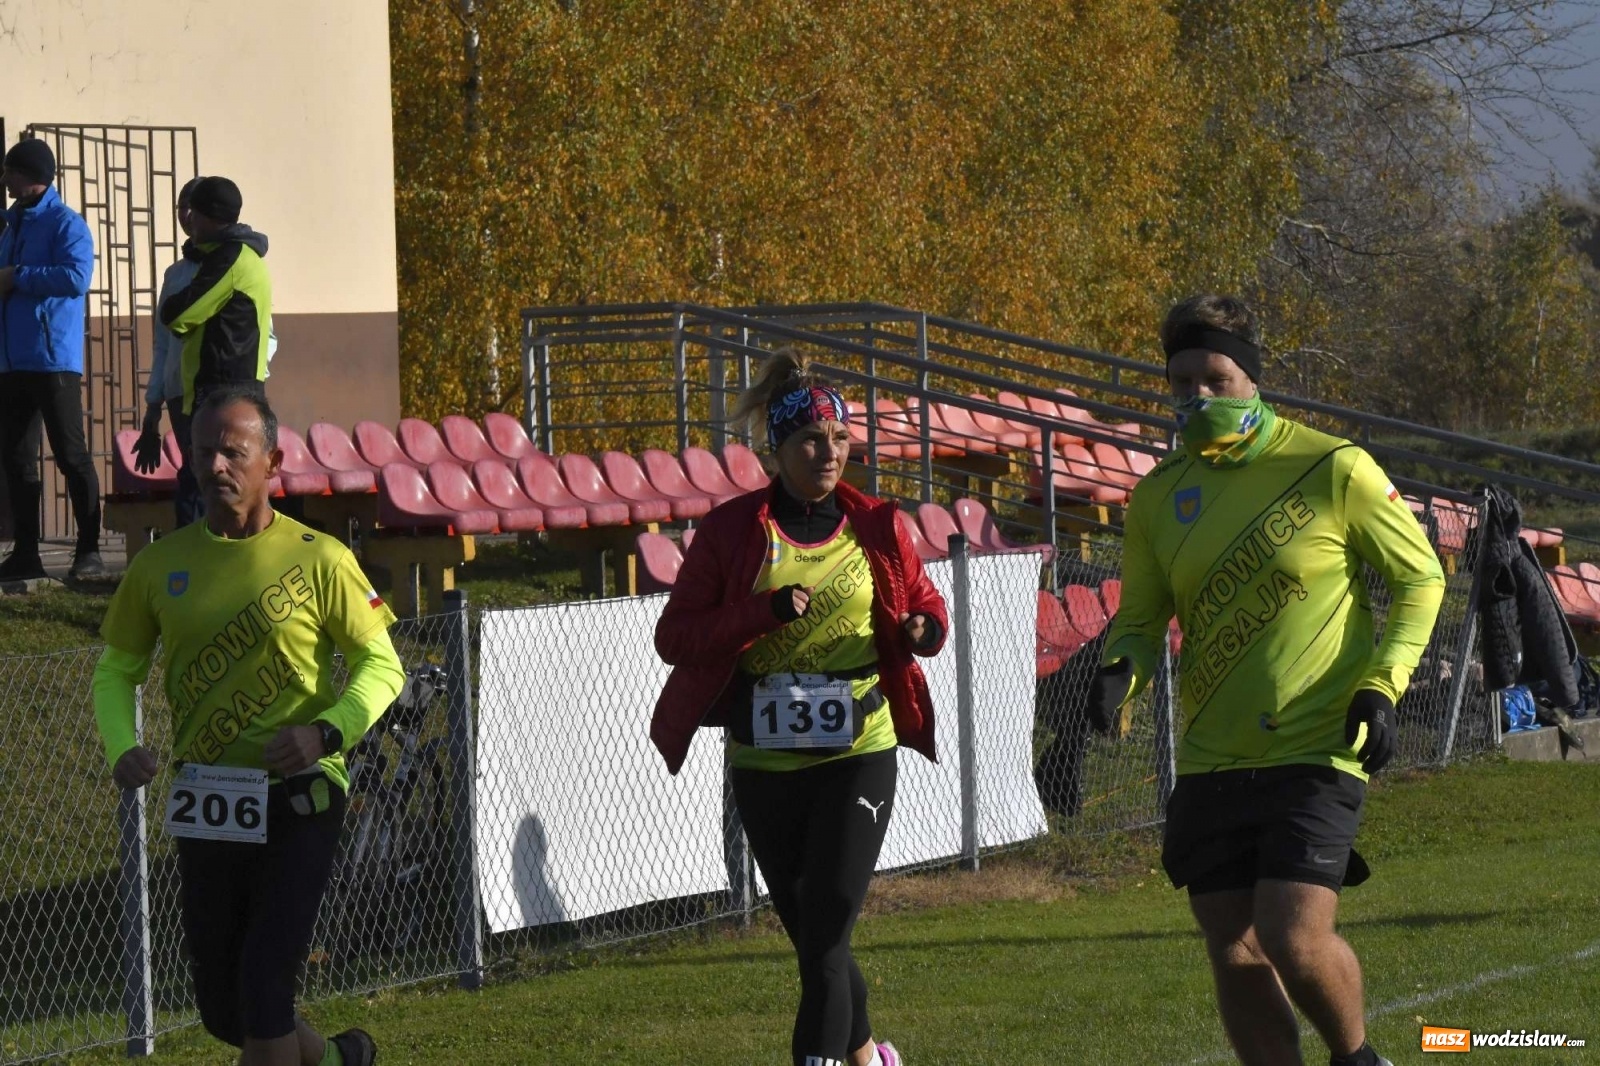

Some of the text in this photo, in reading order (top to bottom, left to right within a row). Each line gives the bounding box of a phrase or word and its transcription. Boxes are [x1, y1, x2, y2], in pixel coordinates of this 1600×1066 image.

[794, 554, 826, 563] deep
[1188, 569, 1308, 704] BIEGAJĄ
[760, 699, 847, 735] 139
[171, 789, 261, 830] 206
